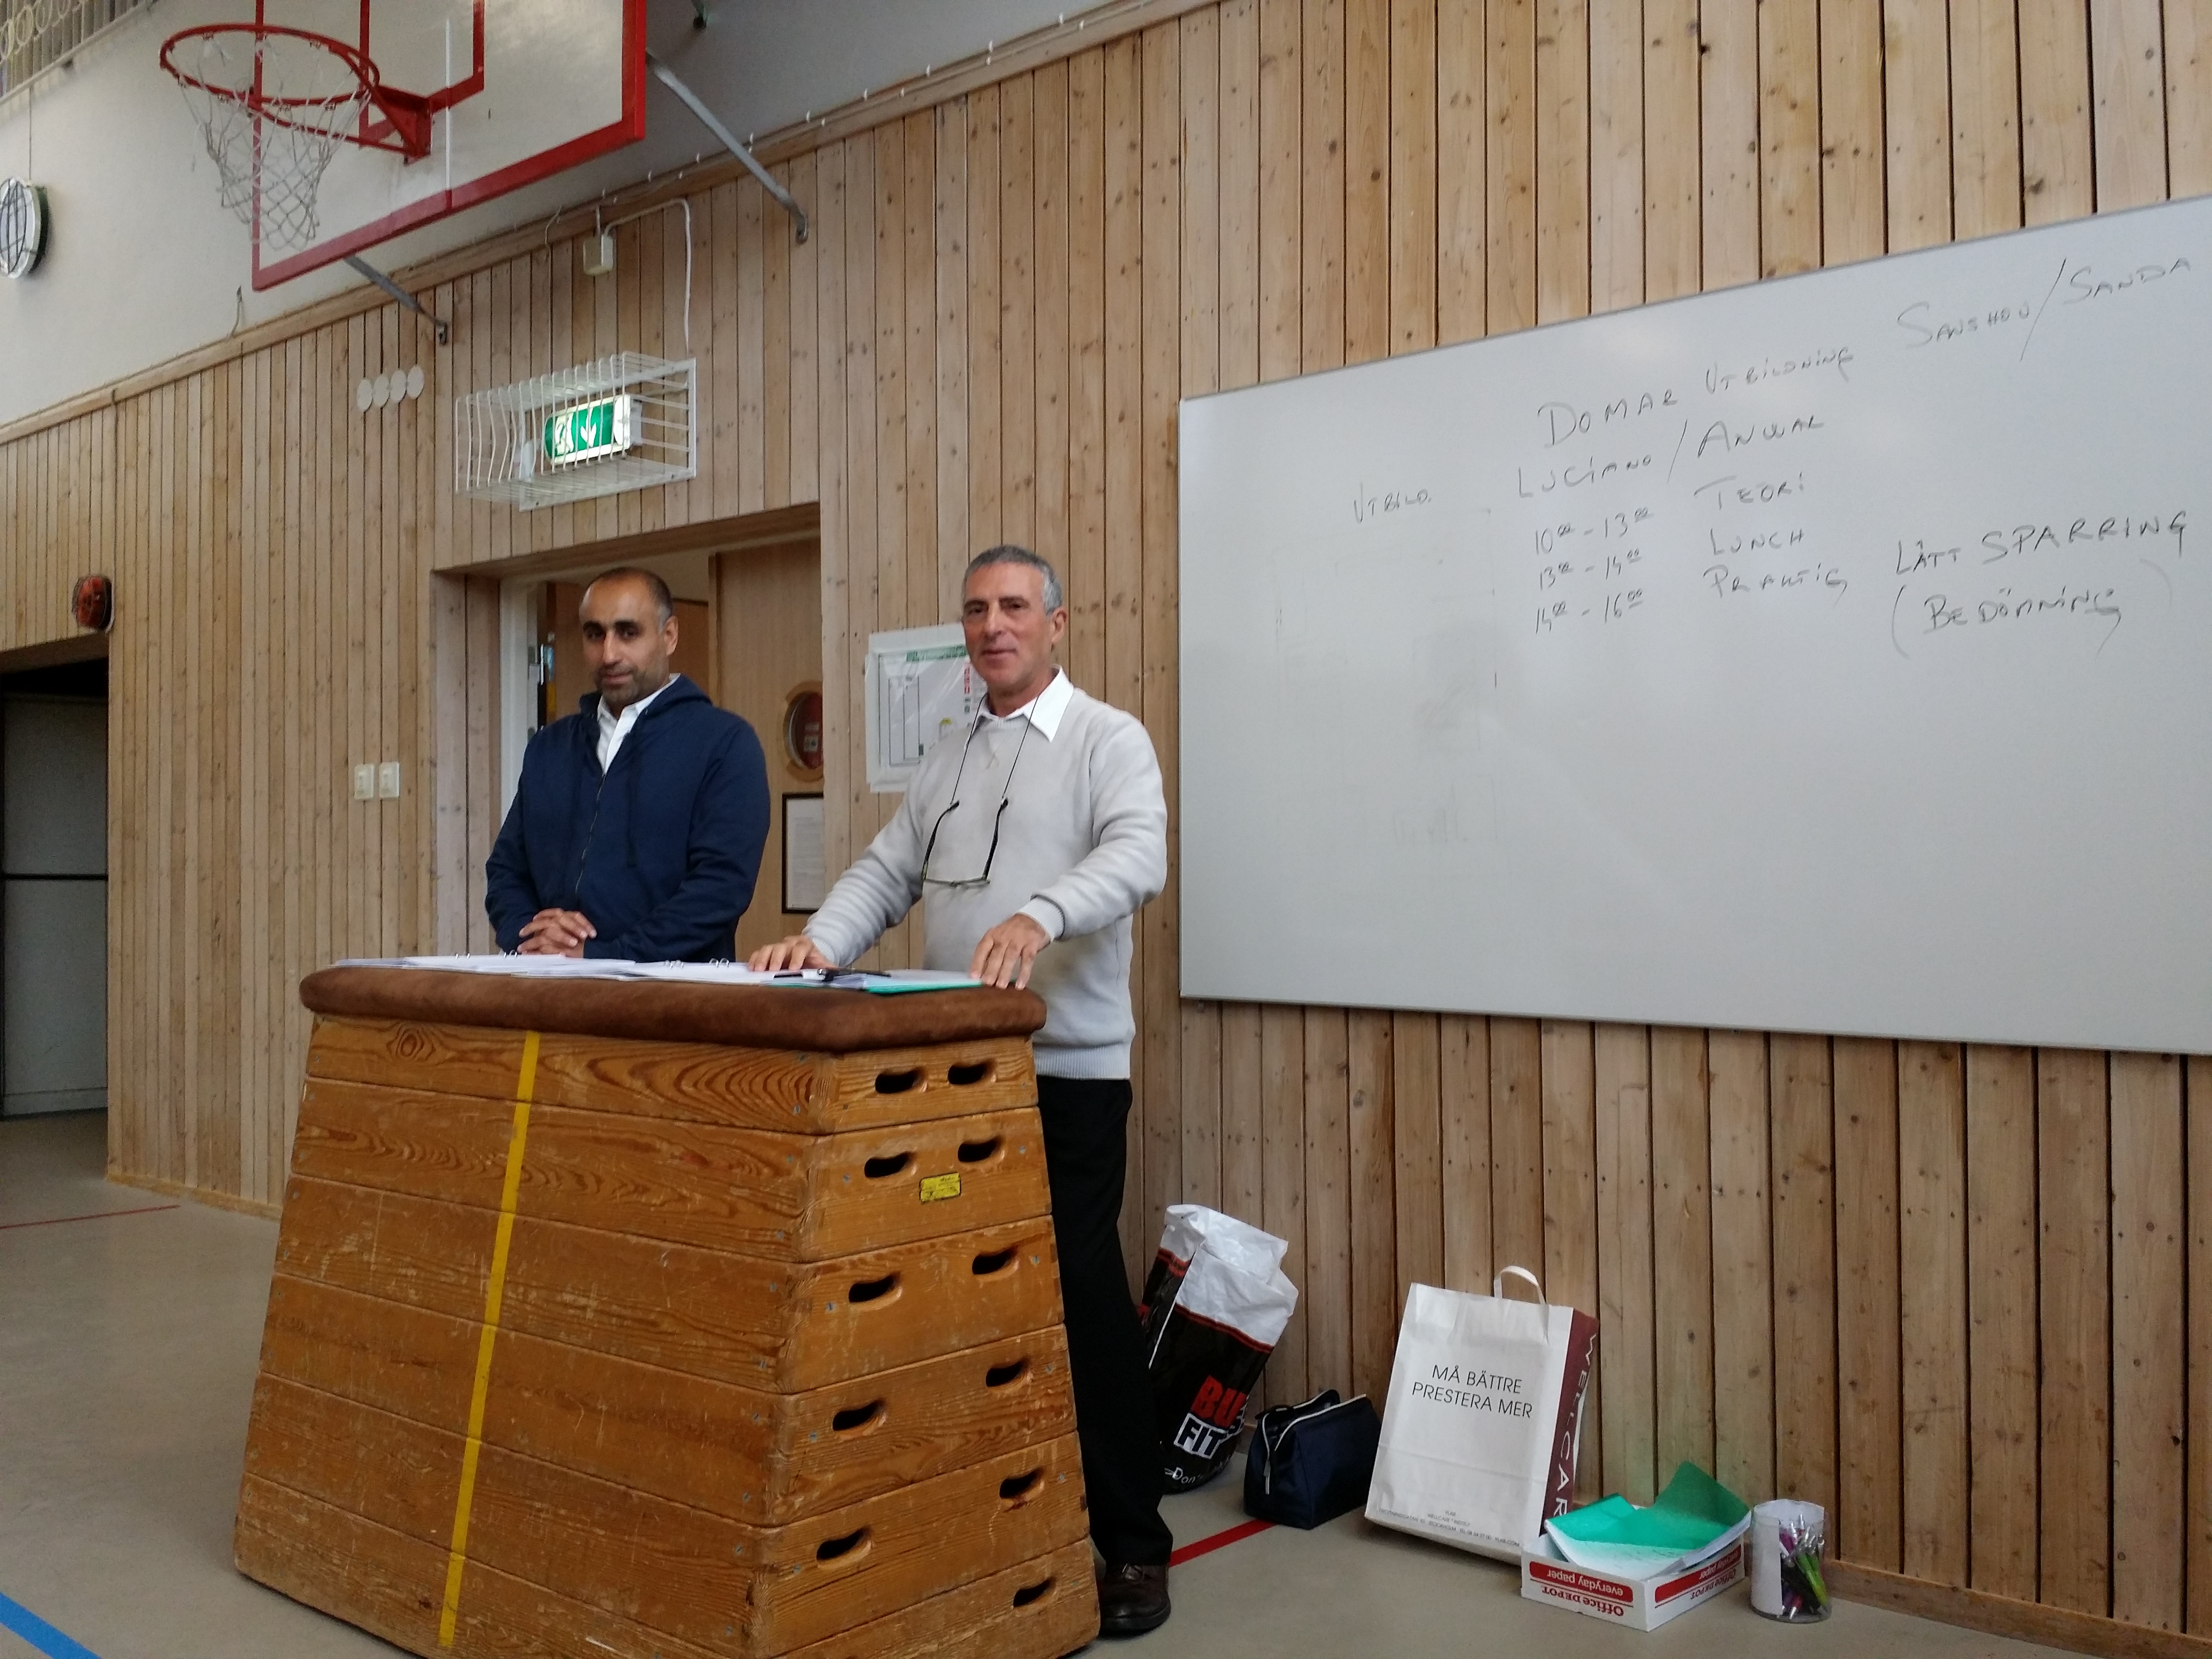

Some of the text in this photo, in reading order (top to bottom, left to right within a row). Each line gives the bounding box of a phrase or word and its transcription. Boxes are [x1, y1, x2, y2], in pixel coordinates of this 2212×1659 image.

[1710, 528, 1804, 556] LUNCH
[1982, 510, 2186, 565] SPARRING
[1432, 1364, 1522, 1394] MÅ BÄTTRE
[1412, 1381, 1533, 1418] PRESTERA MER
[1547, 1570, 1624, 1596] everyday paper
[1690, 1585, 1714, 1600] DEPOT
[1542, 1586, 1624, 1616] Office DEPOT
